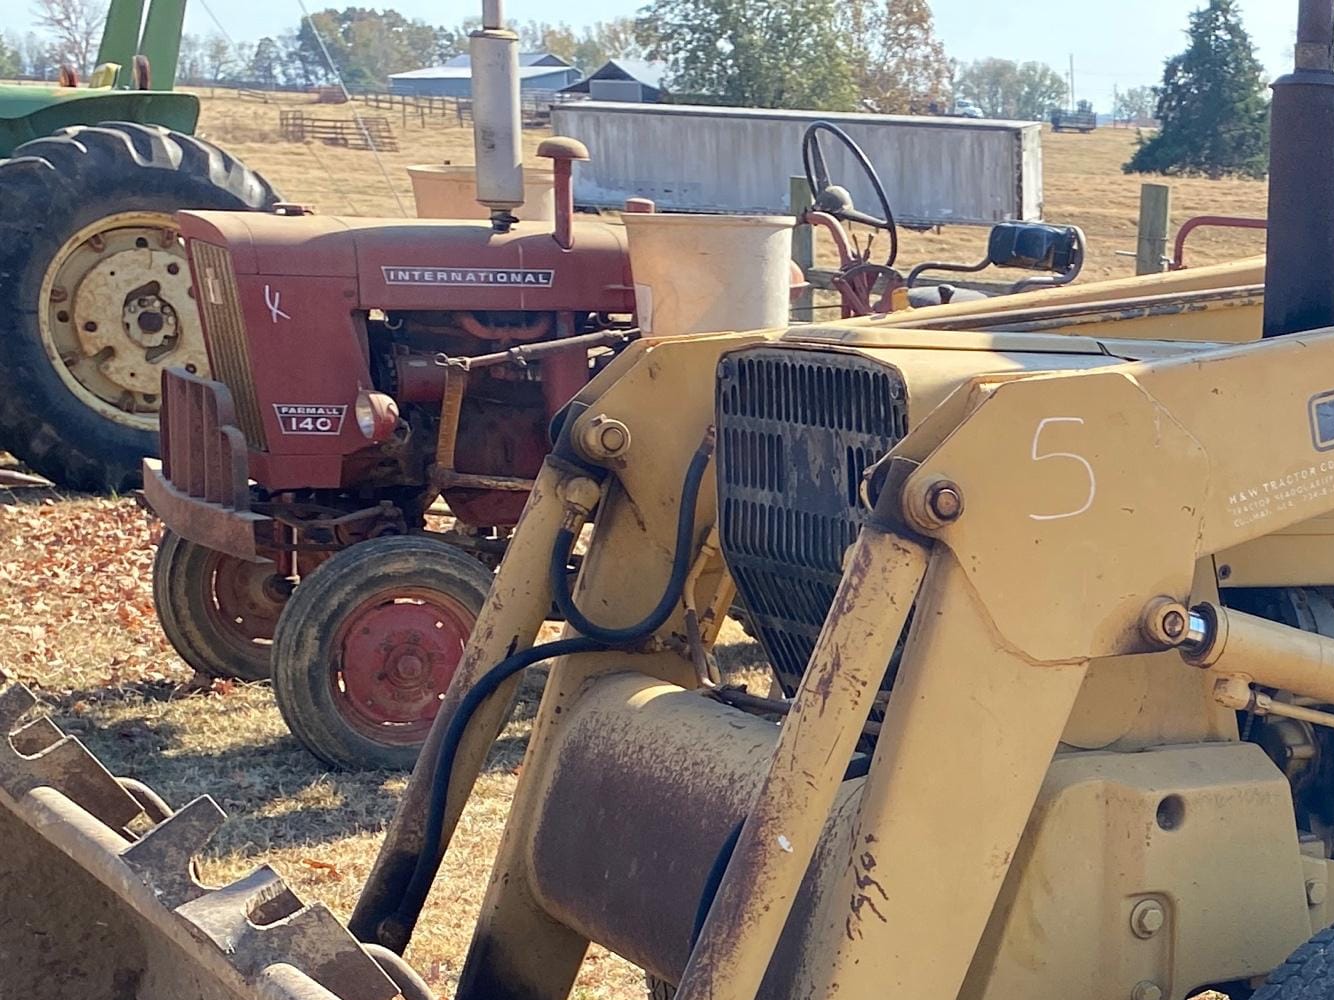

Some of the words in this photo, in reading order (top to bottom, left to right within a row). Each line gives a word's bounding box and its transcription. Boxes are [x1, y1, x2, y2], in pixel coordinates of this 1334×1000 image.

[389, 271, 549, 283] INTERNATIONAL
[291, 417, 332, 431] 140
[1028, 417, 1096, 520] 5
[1262, 467, 1316, 492] TRACTOR
